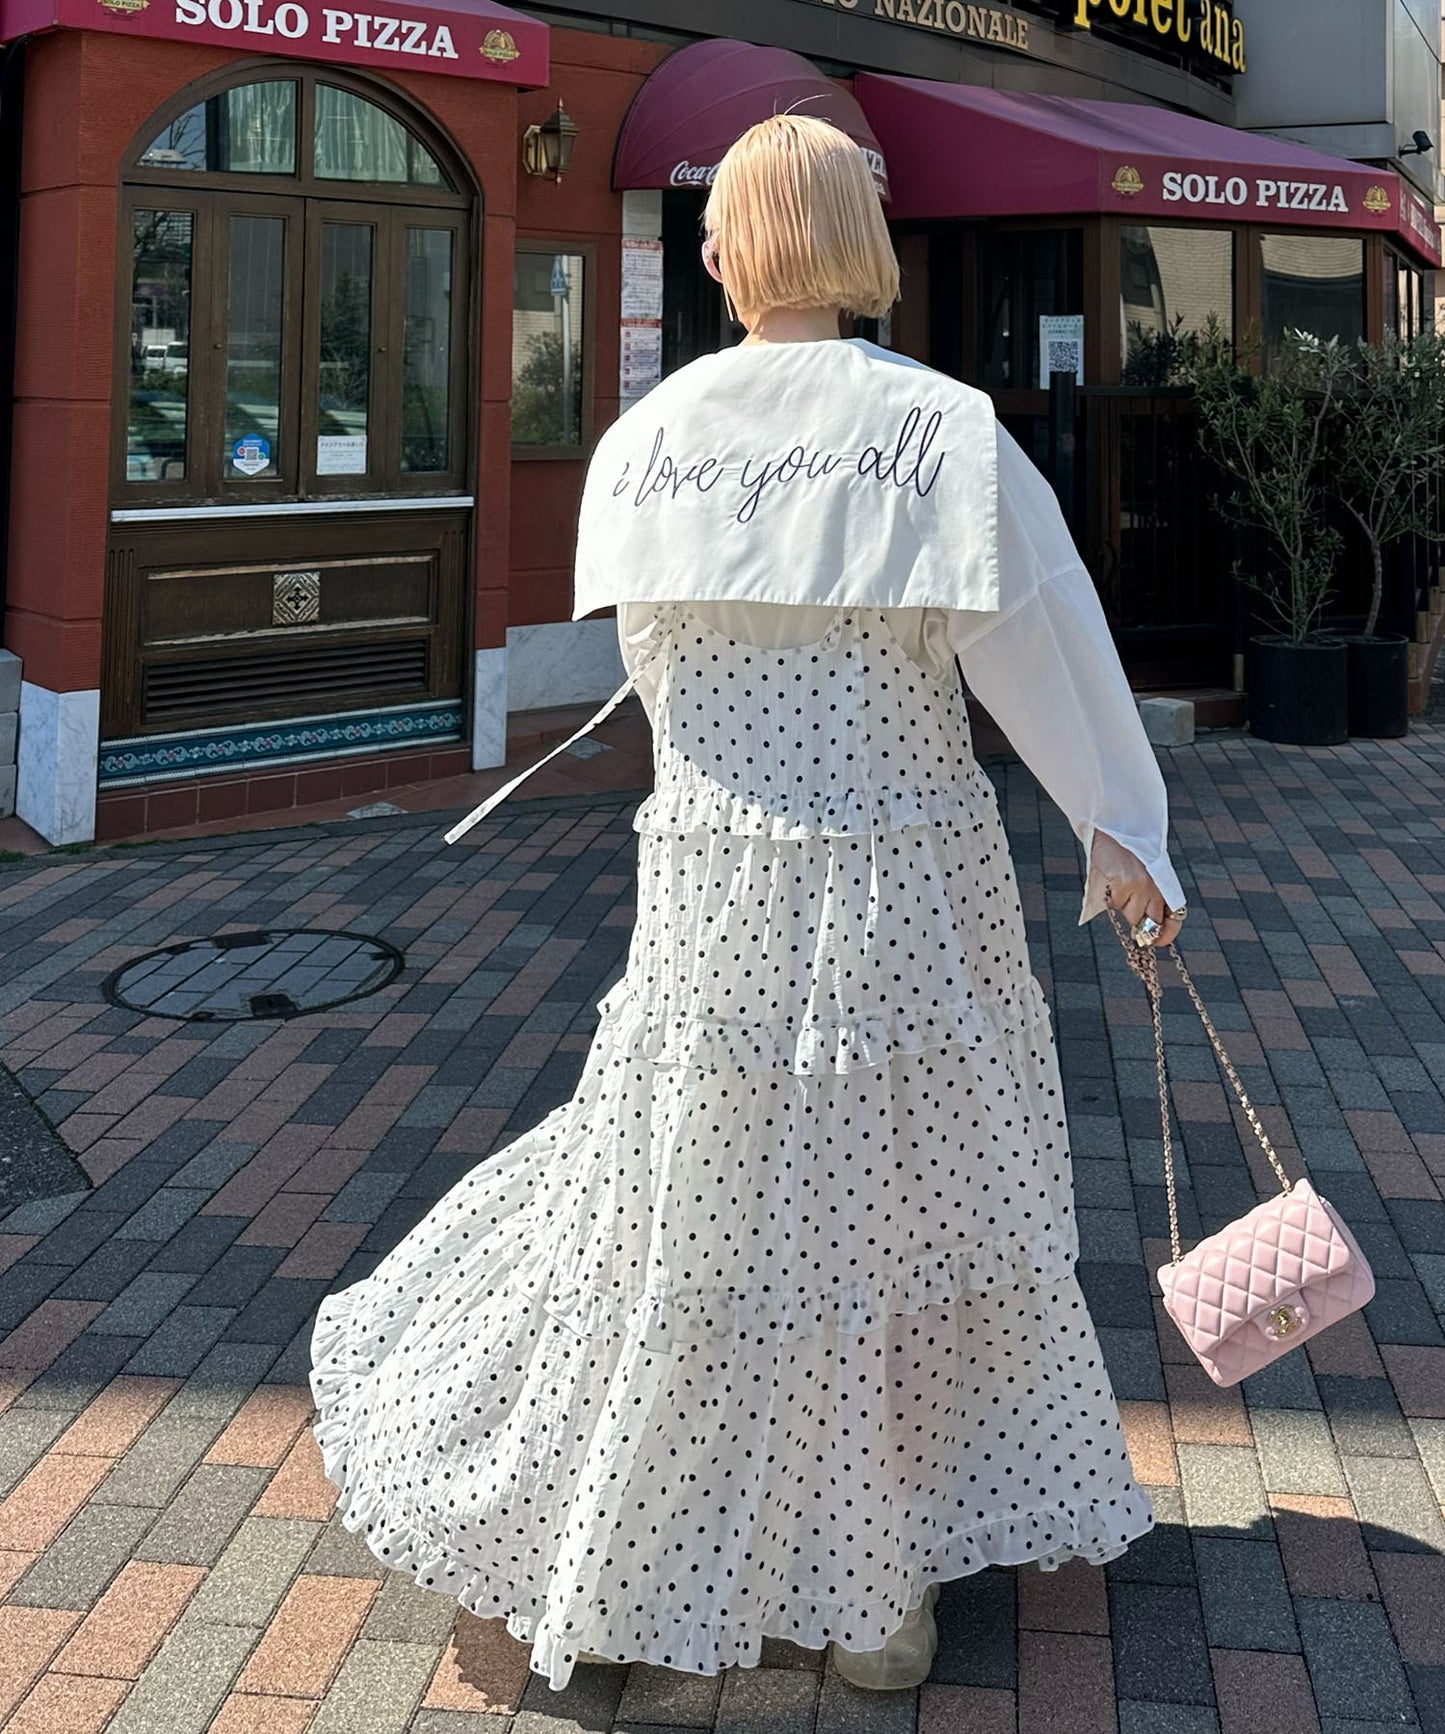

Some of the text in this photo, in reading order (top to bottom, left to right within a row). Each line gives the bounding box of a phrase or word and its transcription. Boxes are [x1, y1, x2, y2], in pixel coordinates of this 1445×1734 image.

[175, 0, 459, 59] SOLO PIZZA
[874, 0, 1029, 50] NAZIONALE
[669, 160, 721, 186] Coca-C
[1162, 172, 1349, 213] SOLO PIZZA
[612, 406, 946, 523] i love you all
